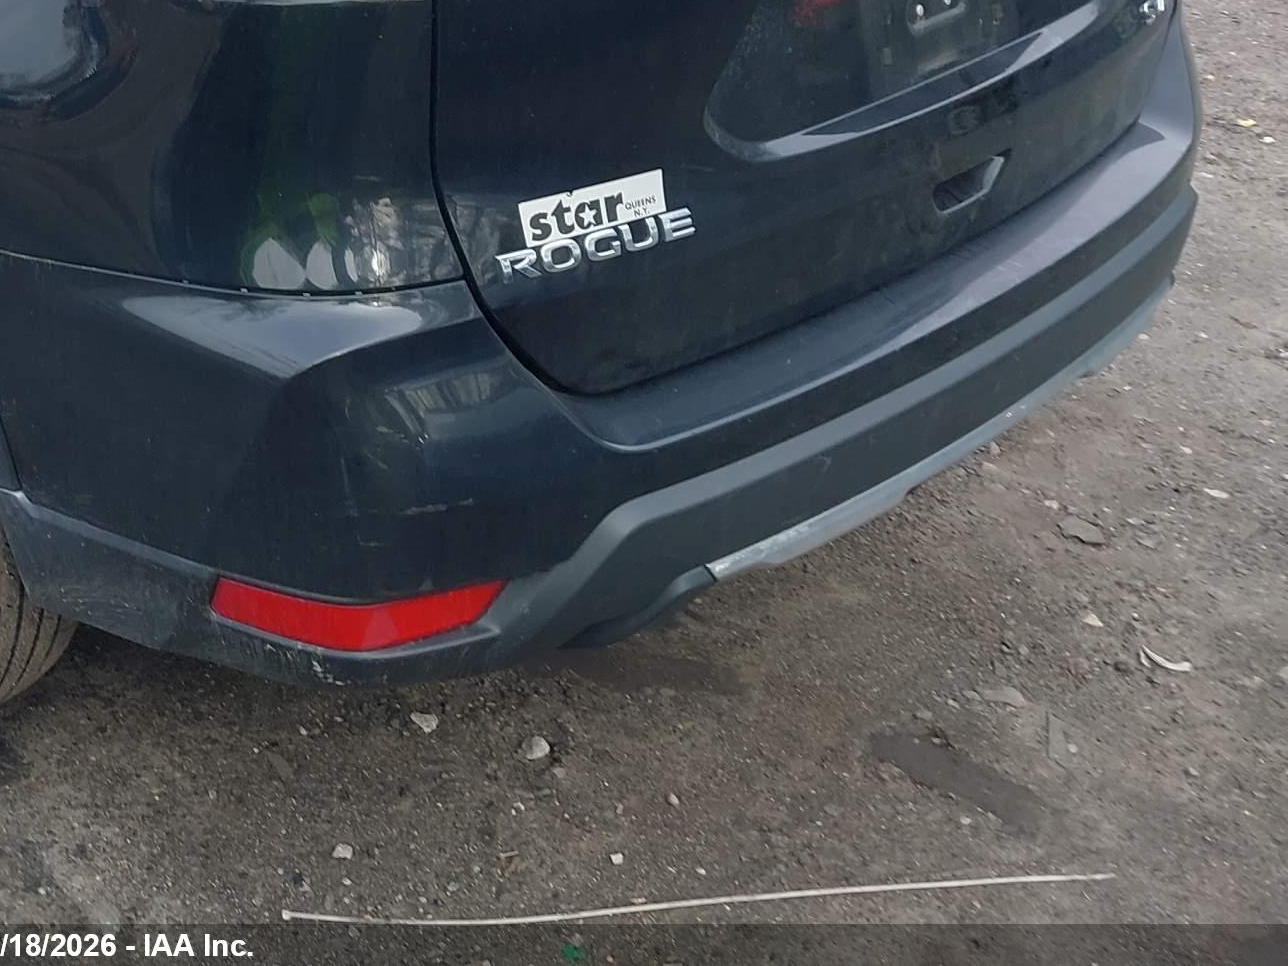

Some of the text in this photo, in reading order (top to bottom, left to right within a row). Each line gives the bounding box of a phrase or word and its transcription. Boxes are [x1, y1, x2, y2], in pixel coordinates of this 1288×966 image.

[529, 192, 623, 241] star
[624, 194, 657, 211] QUEENS
[495, 207, 696, 284] ROGUE
